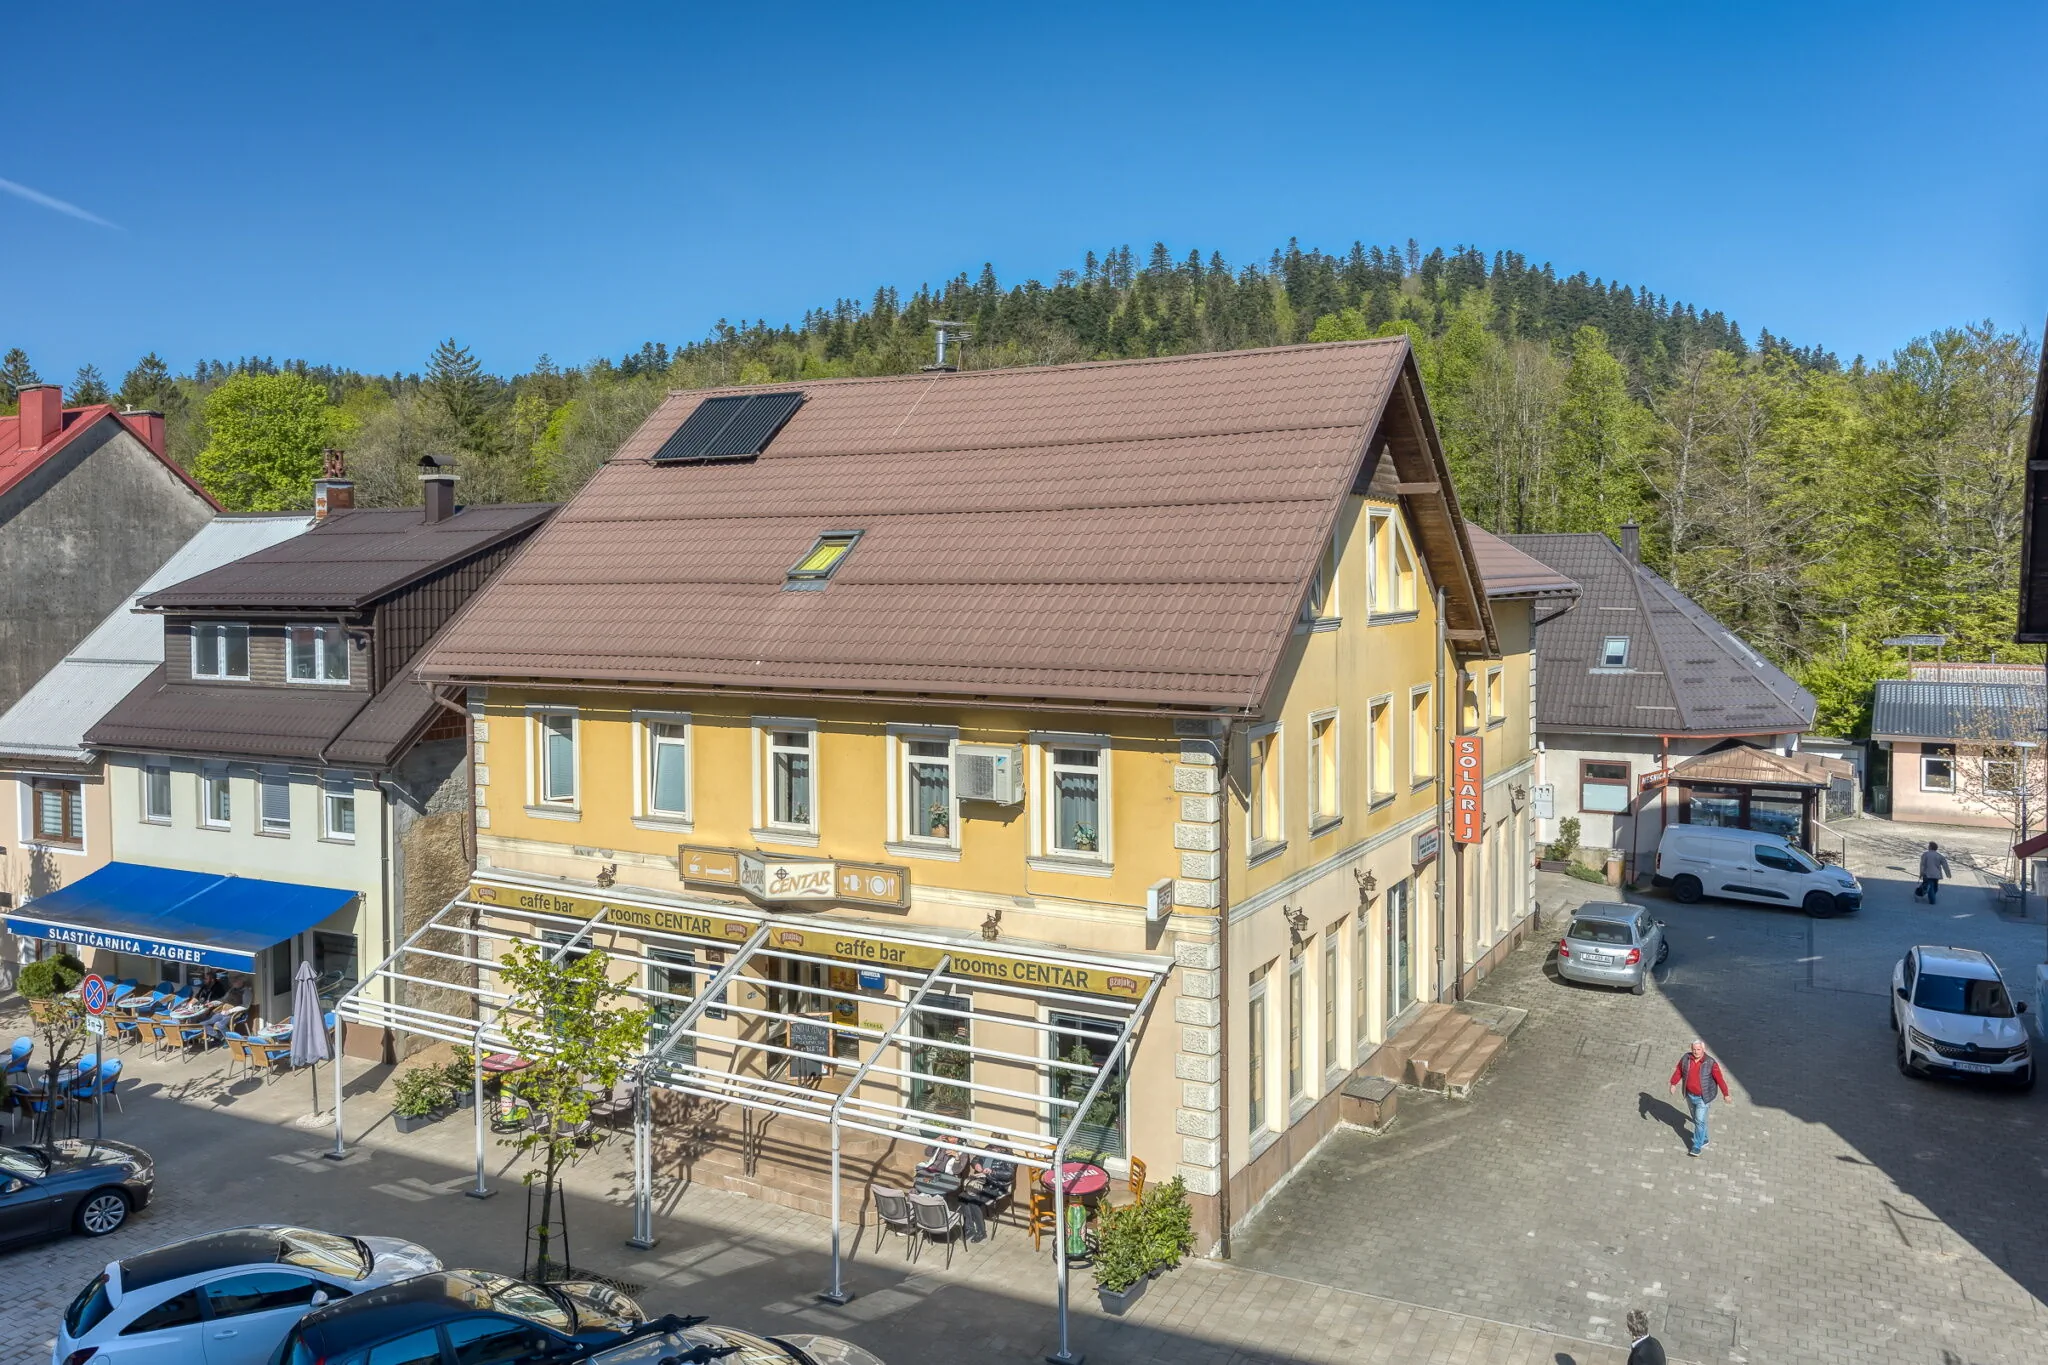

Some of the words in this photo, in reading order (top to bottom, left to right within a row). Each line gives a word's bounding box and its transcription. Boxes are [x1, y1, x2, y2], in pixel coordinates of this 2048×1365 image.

[1459, 741, 1477, 839] SOLARIJ
[741, 867, 764, 885] CENTAR
[768, 870, 831, 895] CENTAR
[520, 893, 552, 912] caffe
[553, 896, 574, 914] bar
[610, 910, 651, 926] rooms
[654, 911, 711, 935] CENTAR
[49, 928, 141, 953] SLASTIČARNICA
[835, 939, 875, 959] caffe
[879, 947, 906, 963] bar
[954, 955, 1008, 978] rooms
[1013, 962, 1088, 989] CENTAR
